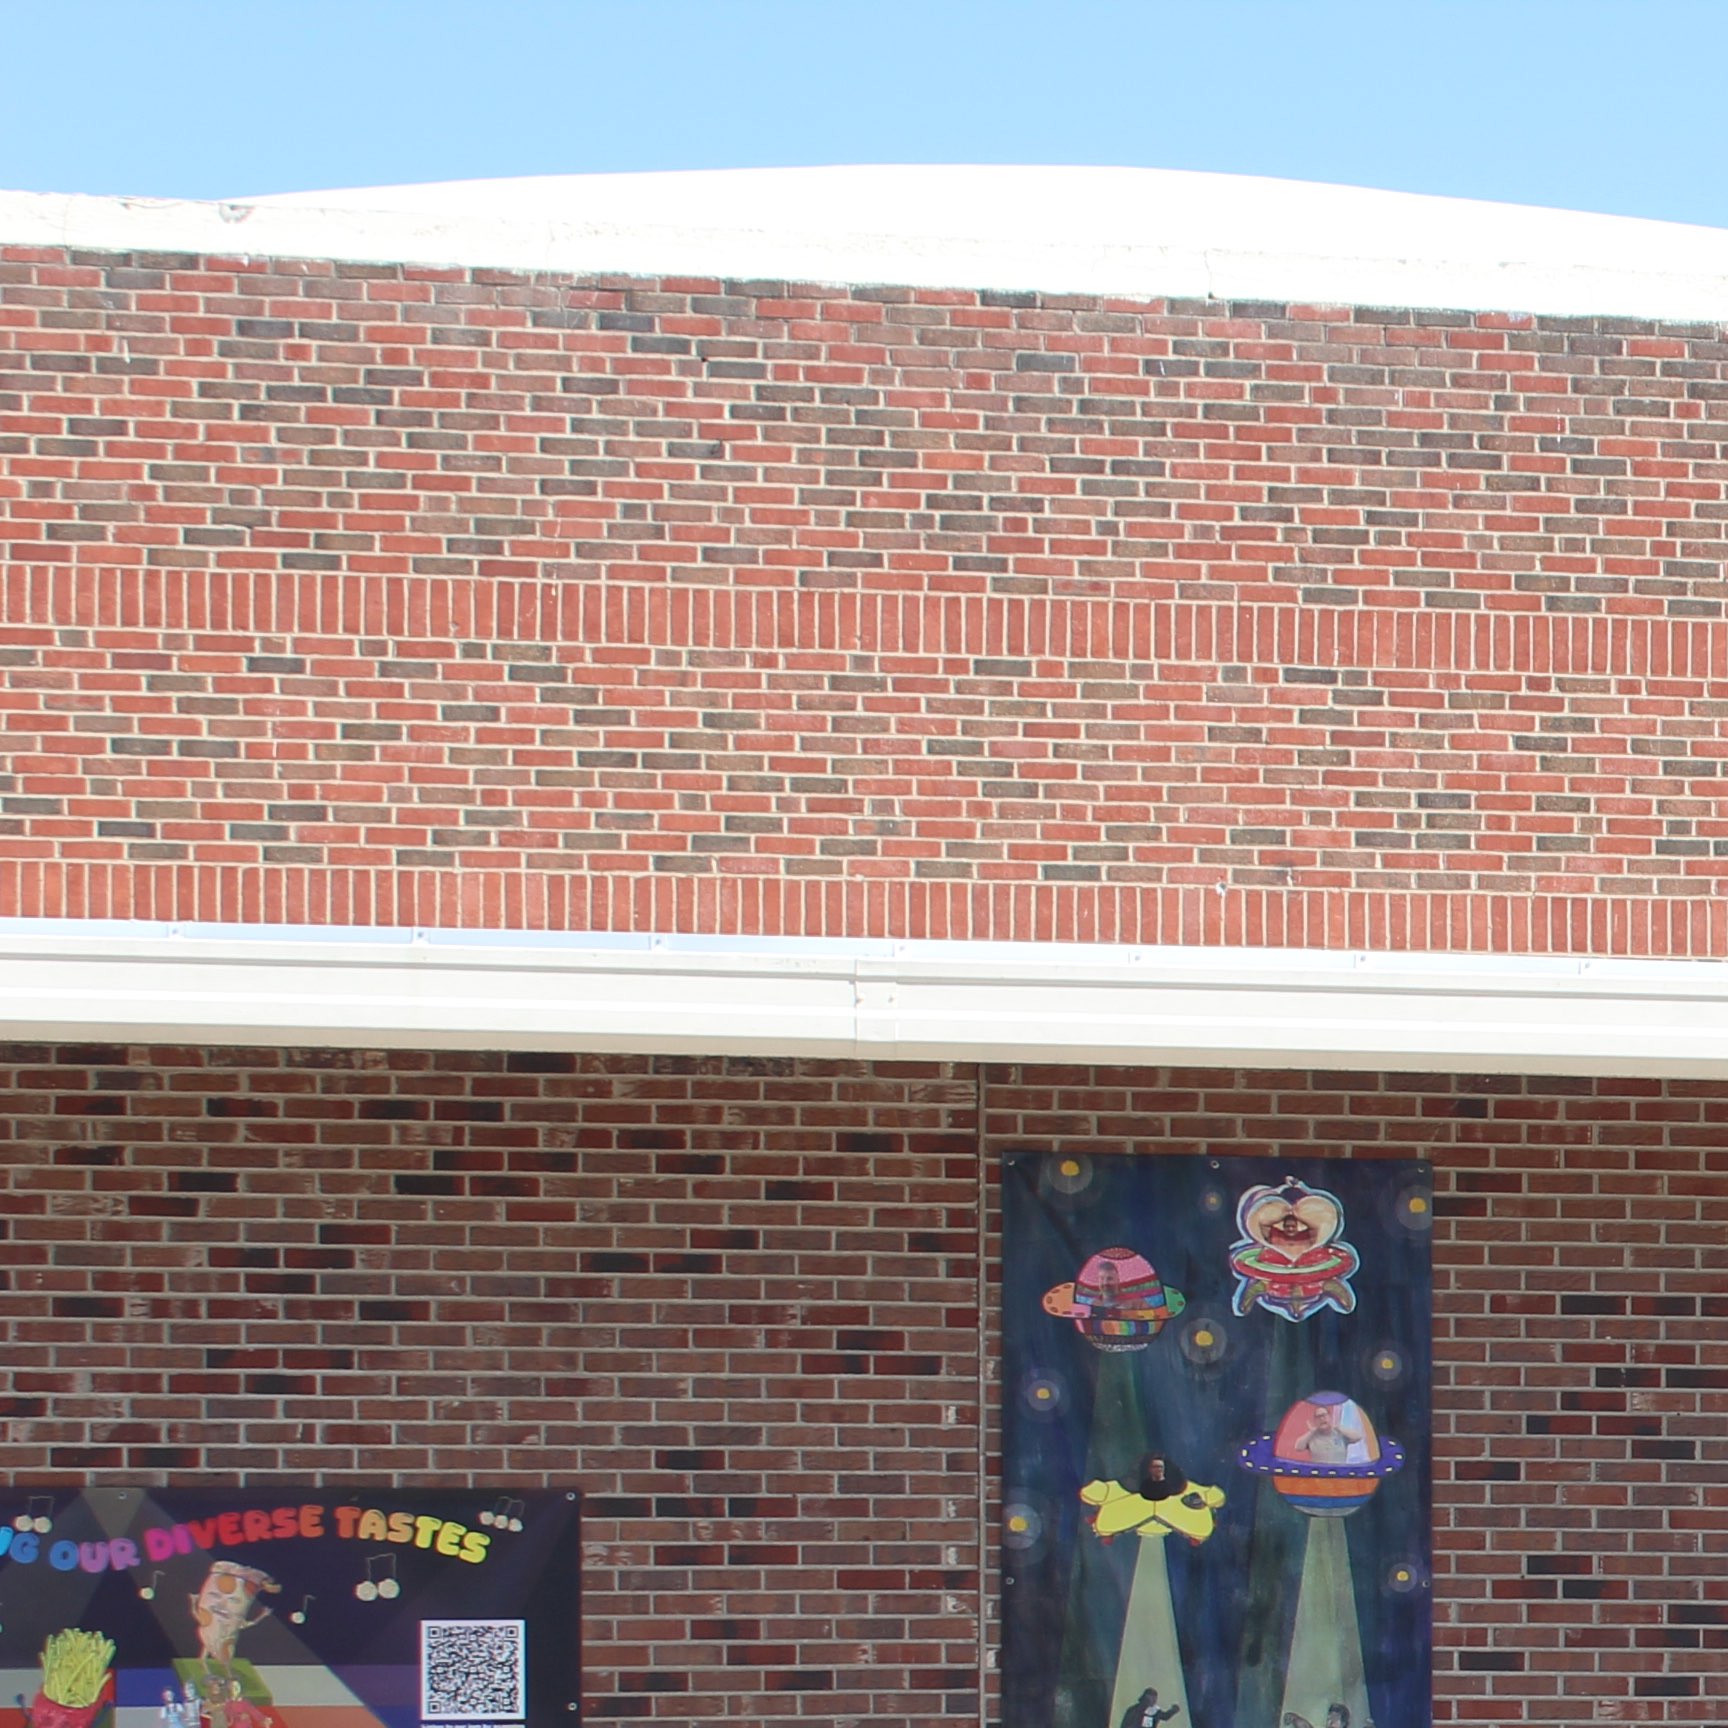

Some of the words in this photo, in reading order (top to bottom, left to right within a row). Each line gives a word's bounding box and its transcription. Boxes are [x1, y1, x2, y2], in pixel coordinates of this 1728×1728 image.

[49, 1538, 140, 1573] OUR
[144, 1505, 324, 1561] DIVERSE
[334, 1505, 491, 1564] TASTES
